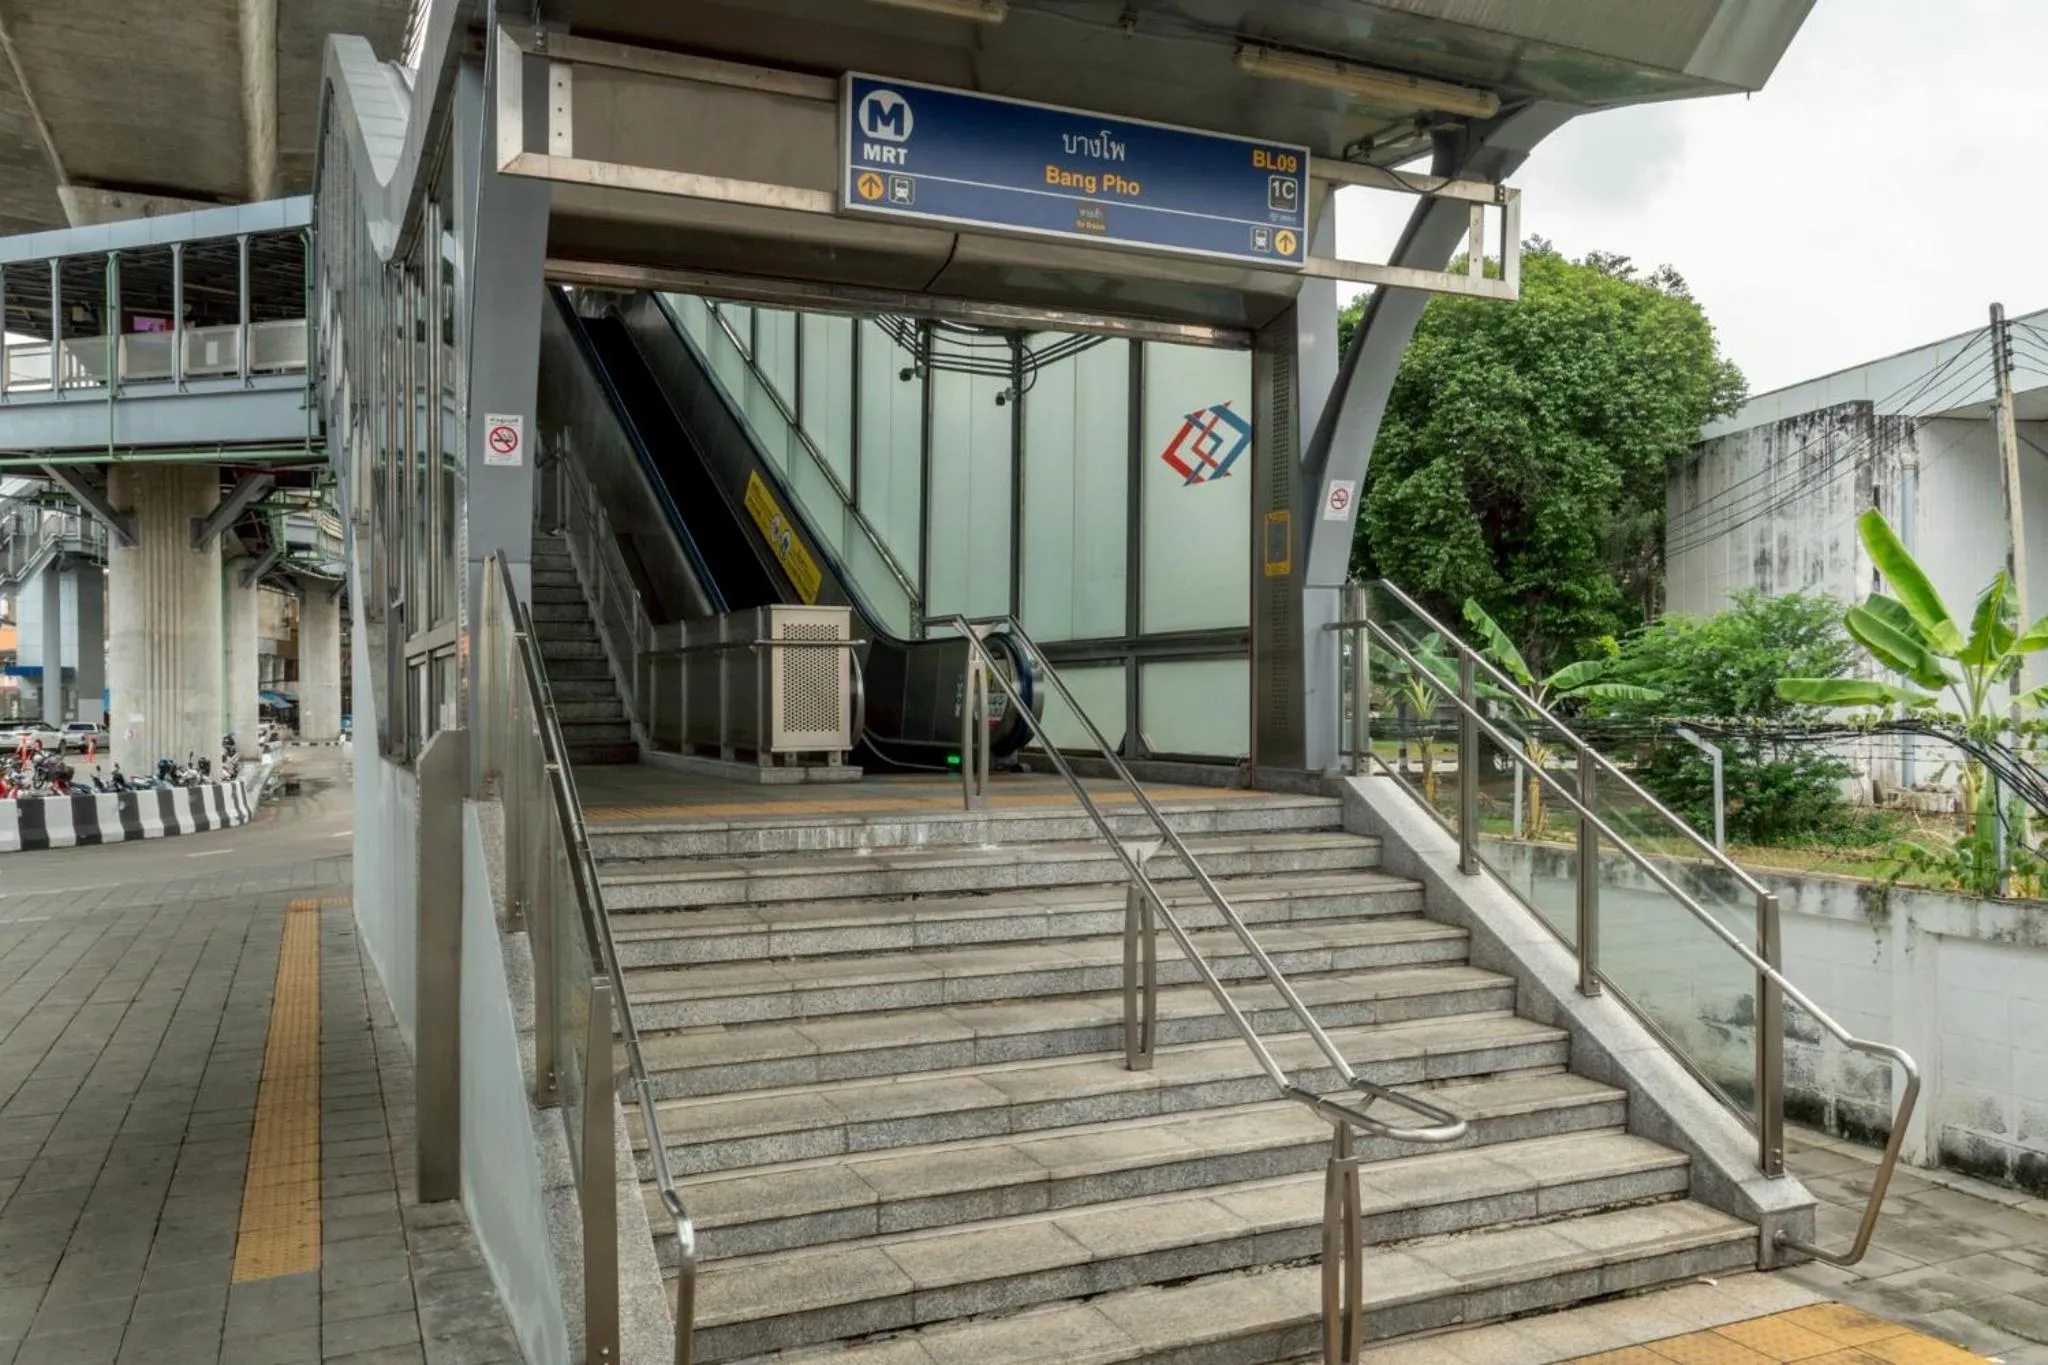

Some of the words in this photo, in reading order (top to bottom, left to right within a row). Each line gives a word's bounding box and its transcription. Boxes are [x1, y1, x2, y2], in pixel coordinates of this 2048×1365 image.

[863, 142, 908, 165] MRT
[1062, 130, 1126, 162] บางโพ
[1252, 149, 1298, 174] BL09
[1045, 164, 1097, 195] Bang
[1102, 173, 1141, 197] Pho
[1271, 180, 1296, 201] 1C
